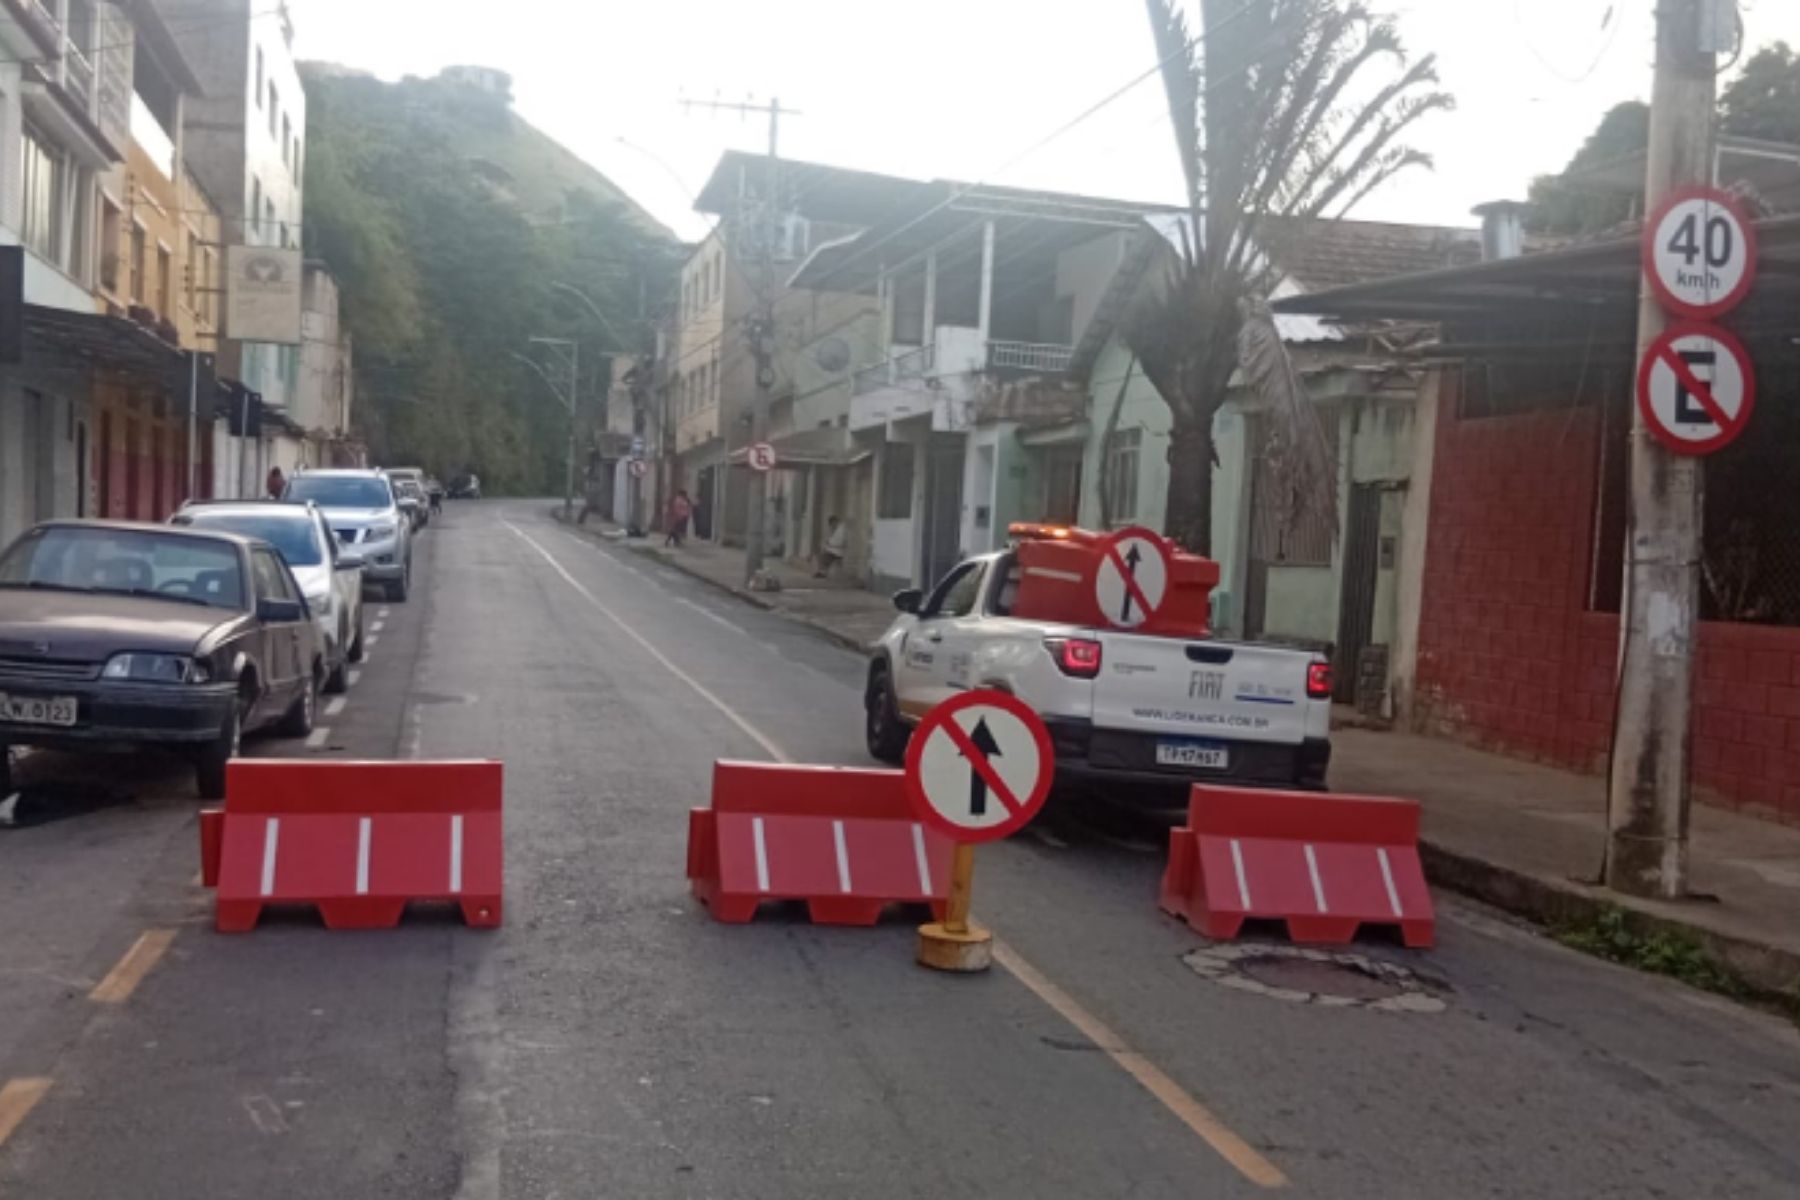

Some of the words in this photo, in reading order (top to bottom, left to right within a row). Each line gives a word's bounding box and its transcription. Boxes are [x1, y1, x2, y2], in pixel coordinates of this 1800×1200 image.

[1667, 213, 1733, 268] 40
[1675, 351, 1717, 424] E
[1189, 670, 1227, 700] FIAT
